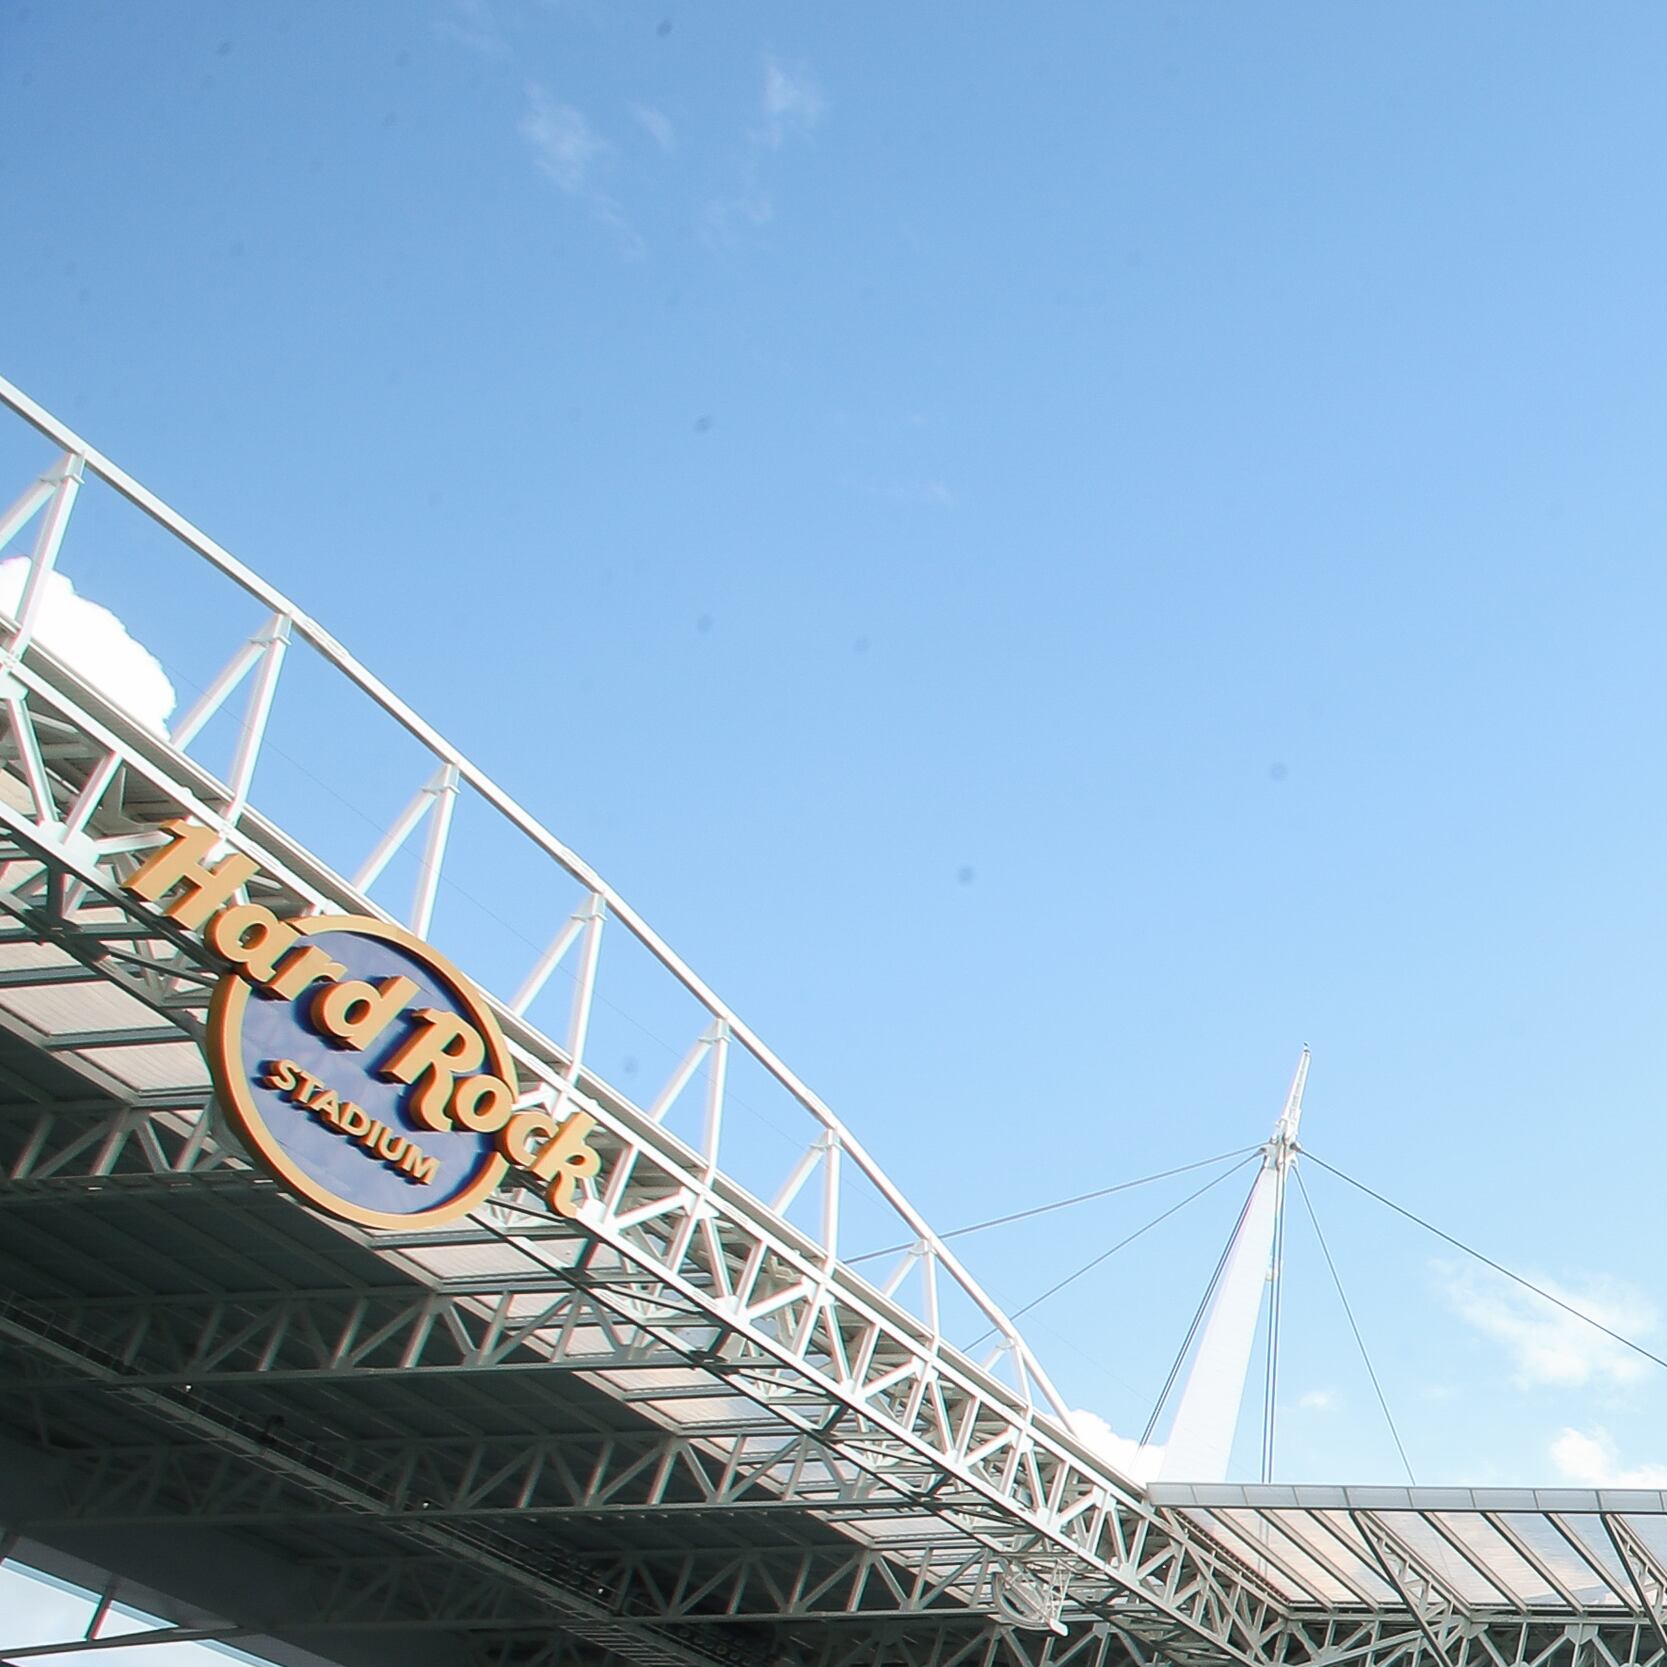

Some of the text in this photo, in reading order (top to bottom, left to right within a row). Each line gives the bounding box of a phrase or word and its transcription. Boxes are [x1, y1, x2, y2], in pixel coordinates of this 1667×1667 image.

[119, 817, 602, 1217] Hard Rock
[262, 1059, 441, 1186] STADIUM
